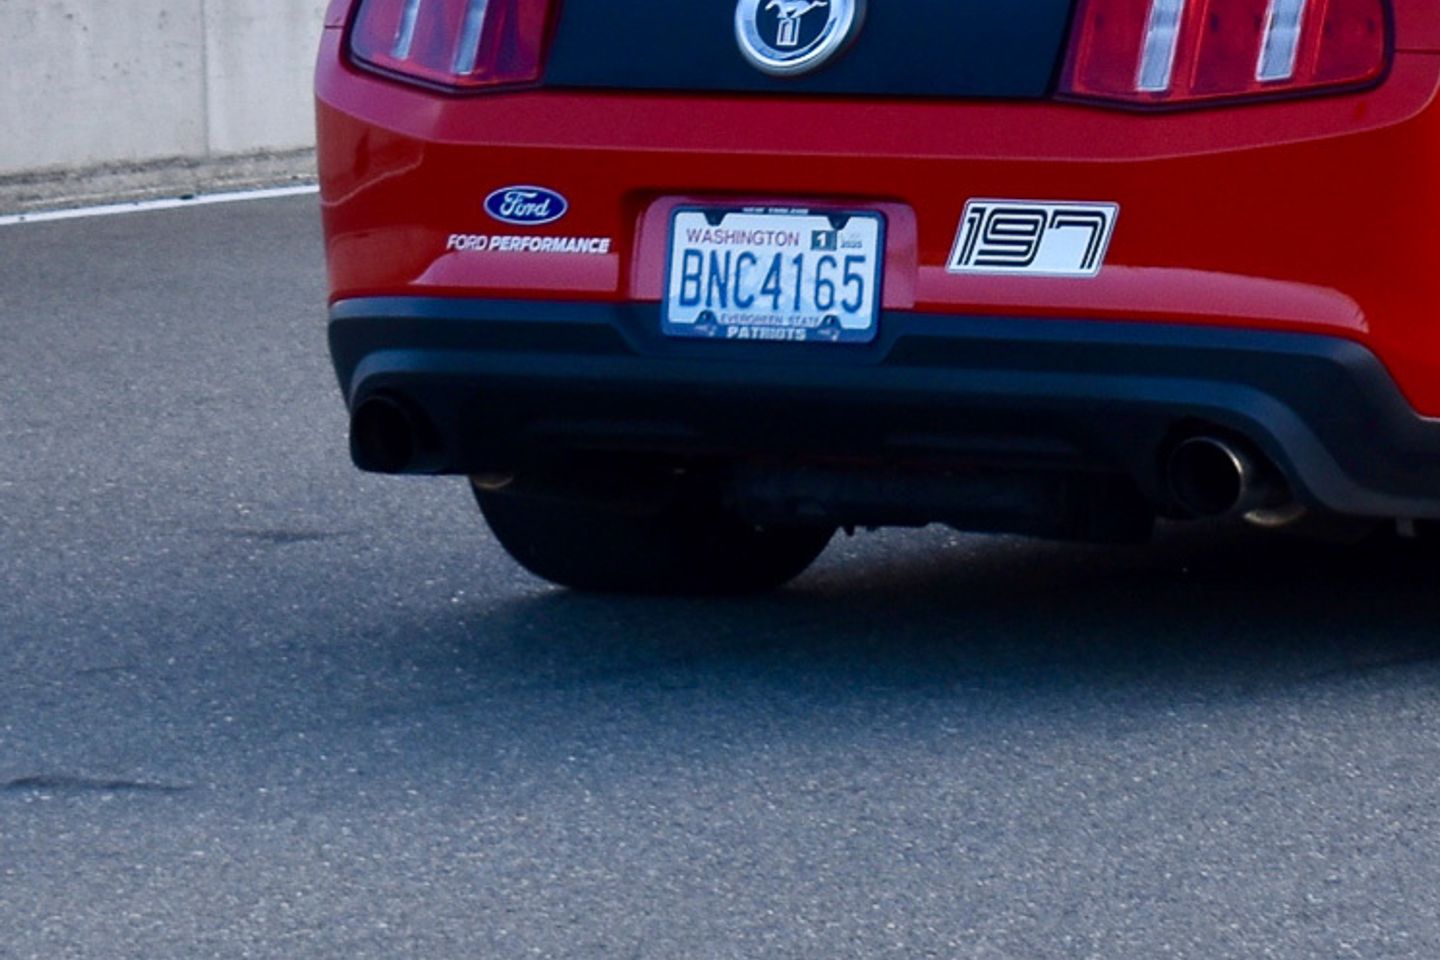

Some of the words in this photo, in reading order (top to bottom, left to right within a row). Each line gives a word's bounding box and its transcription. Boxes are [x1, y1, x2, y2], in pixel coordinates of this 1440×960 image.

[500, 190, 551, 218] Ford
[446, 234, 488, 250] FORD
[488, 235, 612, 254] PERFORMANCE
[686, 227, 800, 247] WASHINGTON
[956, 207, 1107, 270] 197
[678, 248, 867, 314] BNC4165
[725, 325, 807, 341] PATRIOTS
